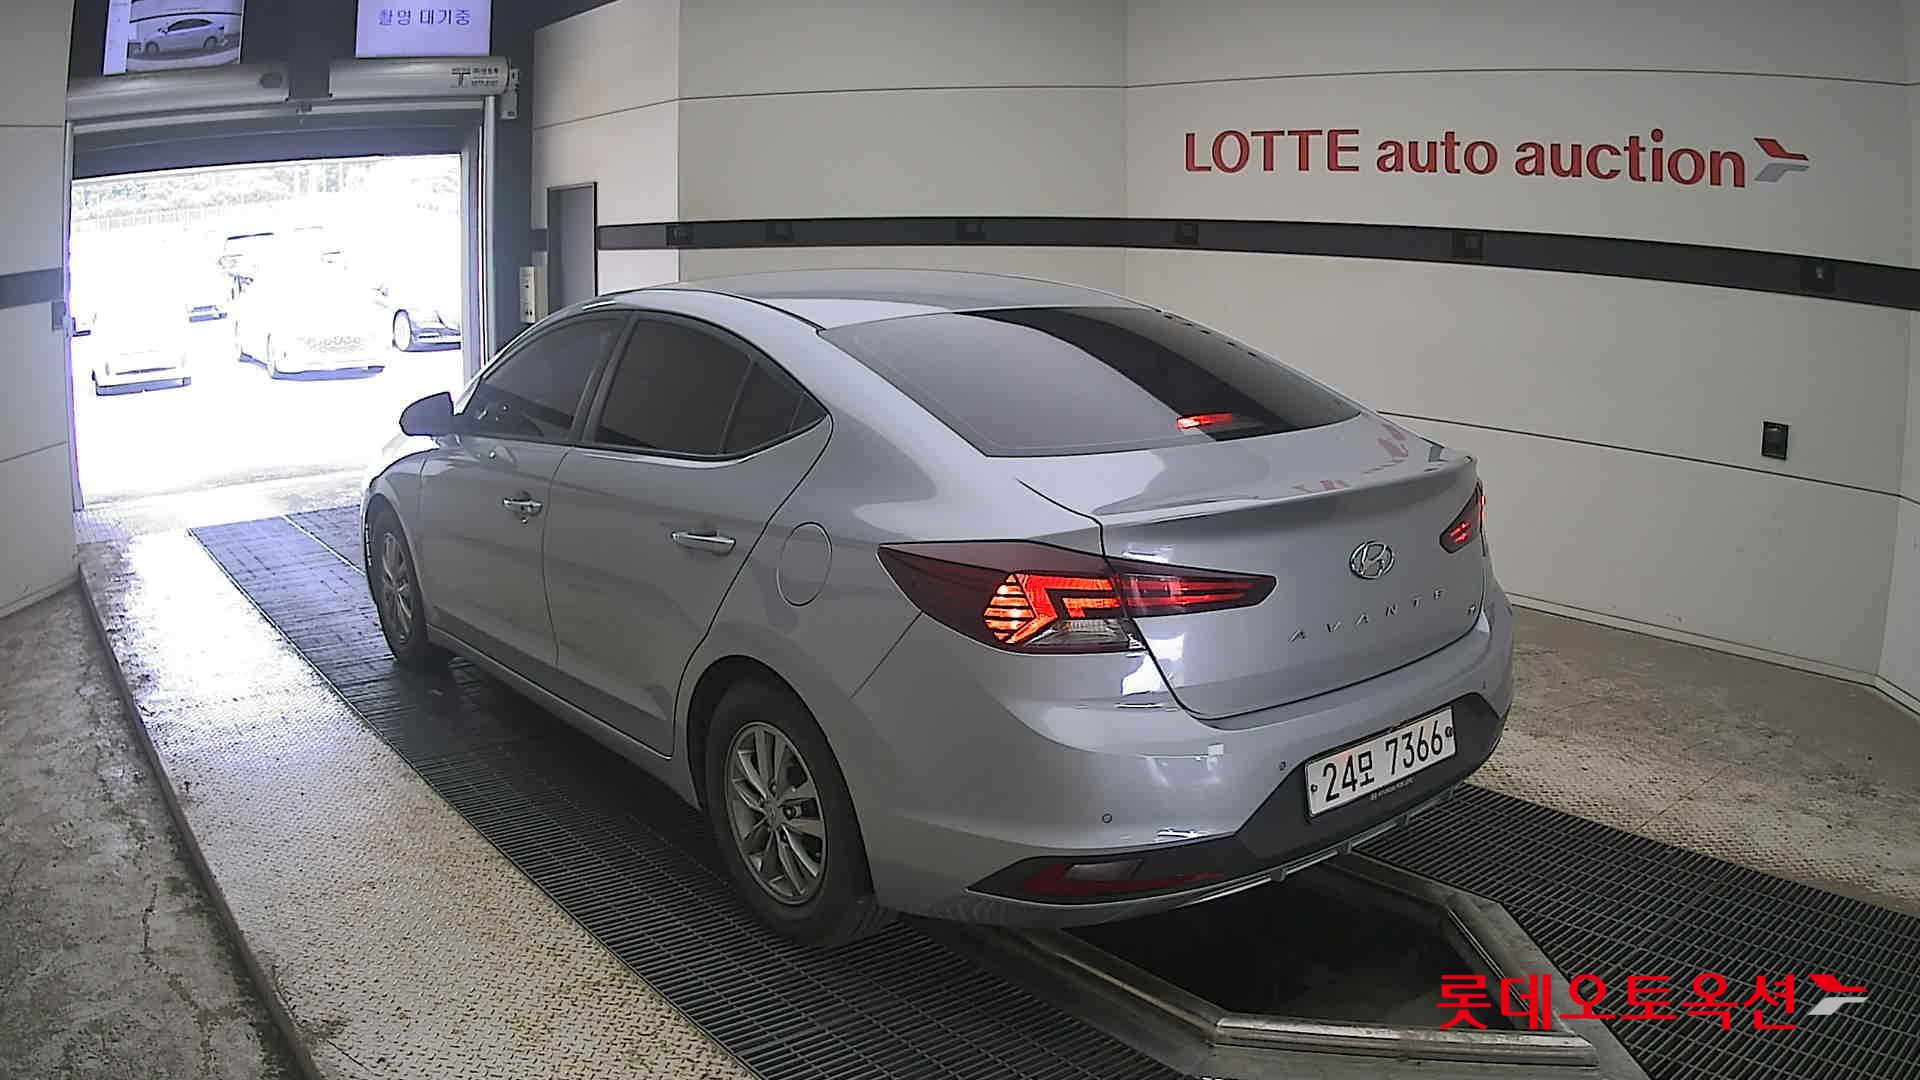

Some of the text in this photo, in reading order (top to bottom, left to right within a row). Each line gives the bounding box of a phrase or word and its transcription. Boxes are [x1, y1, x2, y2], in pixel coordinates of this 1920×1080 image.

[419, 8, 471, 26] 대기중
[1185, 128, 1745, 188] LOTTE auto auction
[1288, 589, 1444, 643] AVANTE
[1322, 751, 1375, 802] 24모
[1385, 720, 1443, 775] 7366
